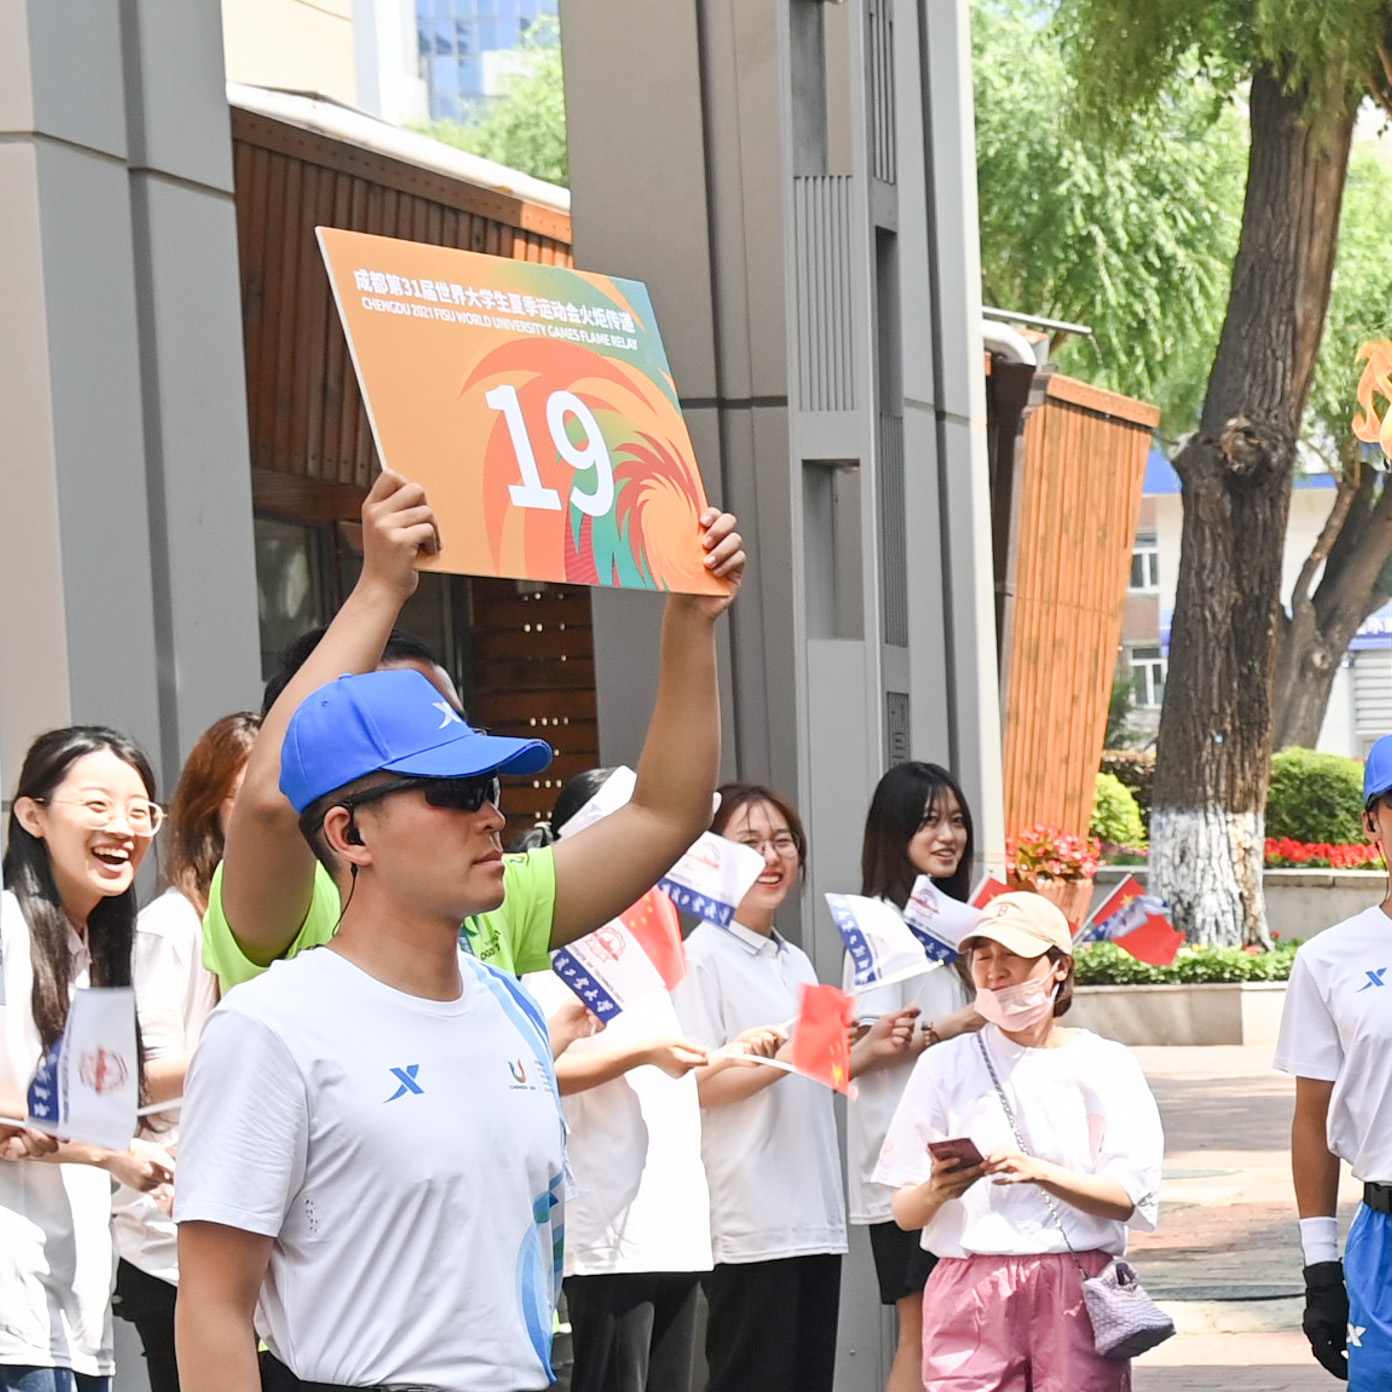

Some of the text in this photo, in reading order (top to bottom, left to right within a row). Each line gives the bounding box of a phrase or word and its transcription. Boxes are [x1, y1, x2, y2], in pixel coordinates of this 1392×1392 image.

[353, 269, 636, 334] 成都第31届世界大学生夏季运动会火炬传递
[361, 296, 638, 350] CHENGDU 2021 FISU WORLD UNIVERSITY GAMES FLAME RELAY
[485, 385, 615, 516] 19
